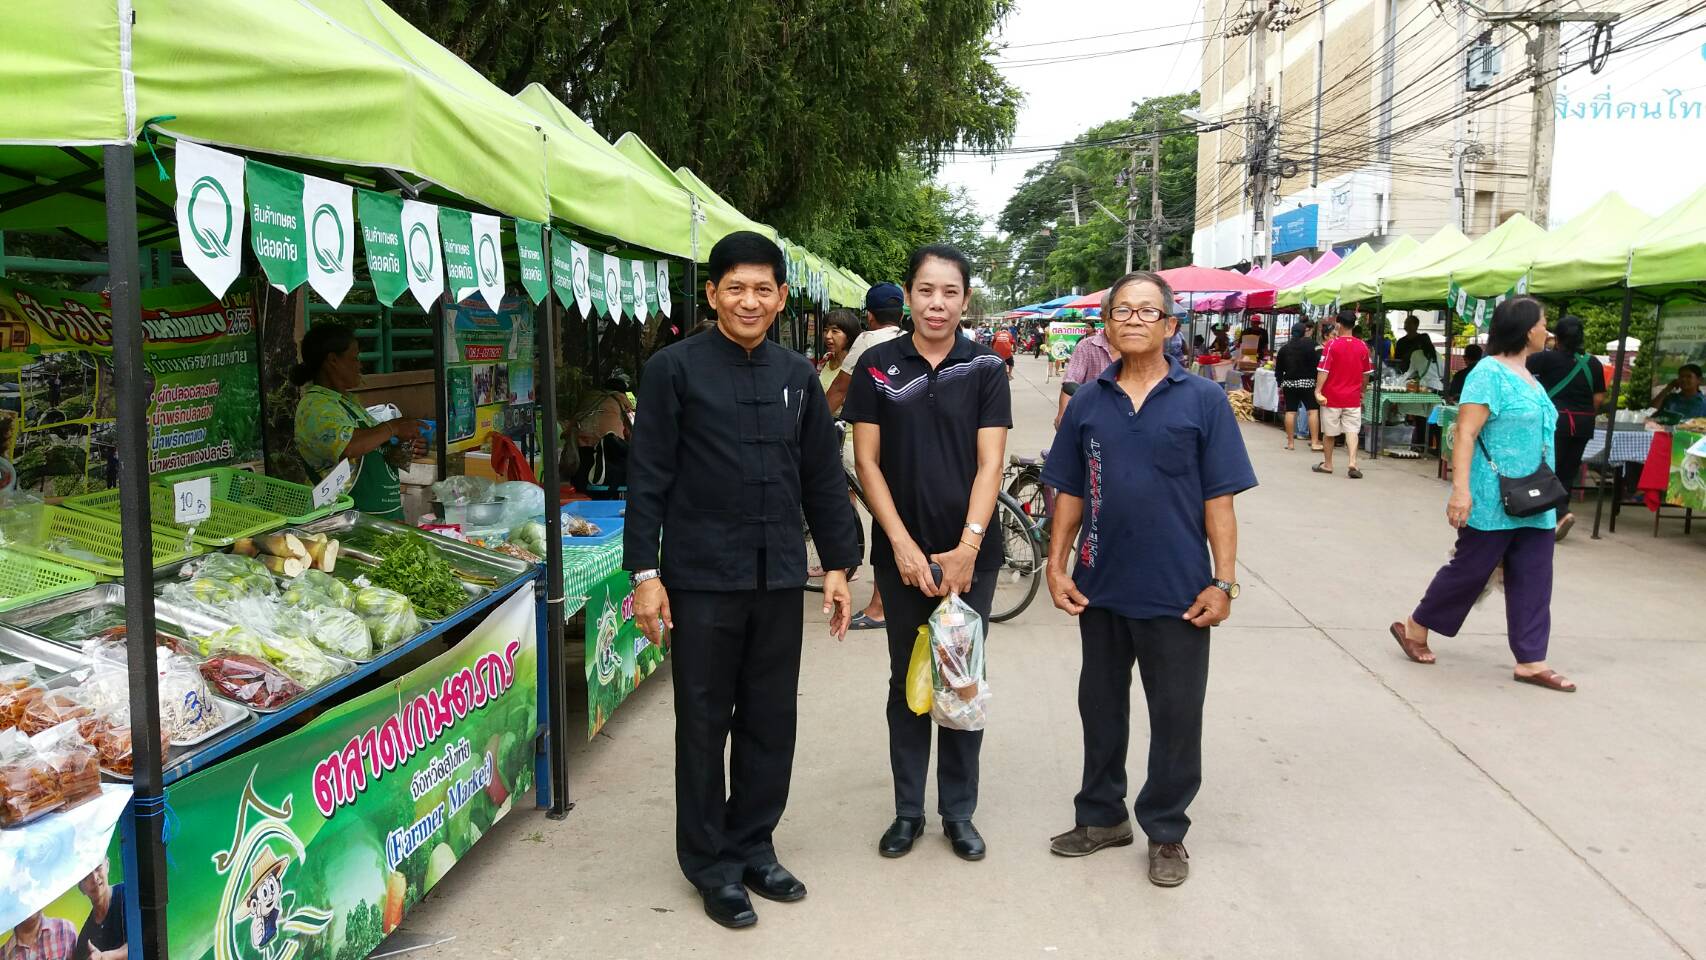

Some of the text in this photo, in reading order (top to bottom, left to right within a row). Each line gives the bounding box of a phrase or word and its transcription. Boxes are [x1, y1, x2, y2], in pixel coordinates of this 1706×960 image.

[188, 176, 232, 258] Q
[253, 203, 297, 230] สินค้าเกษตร
[311, 203, 345, 274] Q
[364, 226, 399, 246] สินค้าเกษตร
[256, 231, 298, 262] ปลอดภัย
[368, 251, 400, 273] ปลอดภัย
[408, 221, 434, 283] Q
[478, 233, 498, 287] Q
[180, 491, 193, 512] 10
[321, 482, 330, 497] 5
[312, 639, 520, 817] ตลาดเกษตรกร
[410, 737, 471, 801] จังหวัดสุโขทัย
[386, 751, 493, 871] (Farmer Market)
